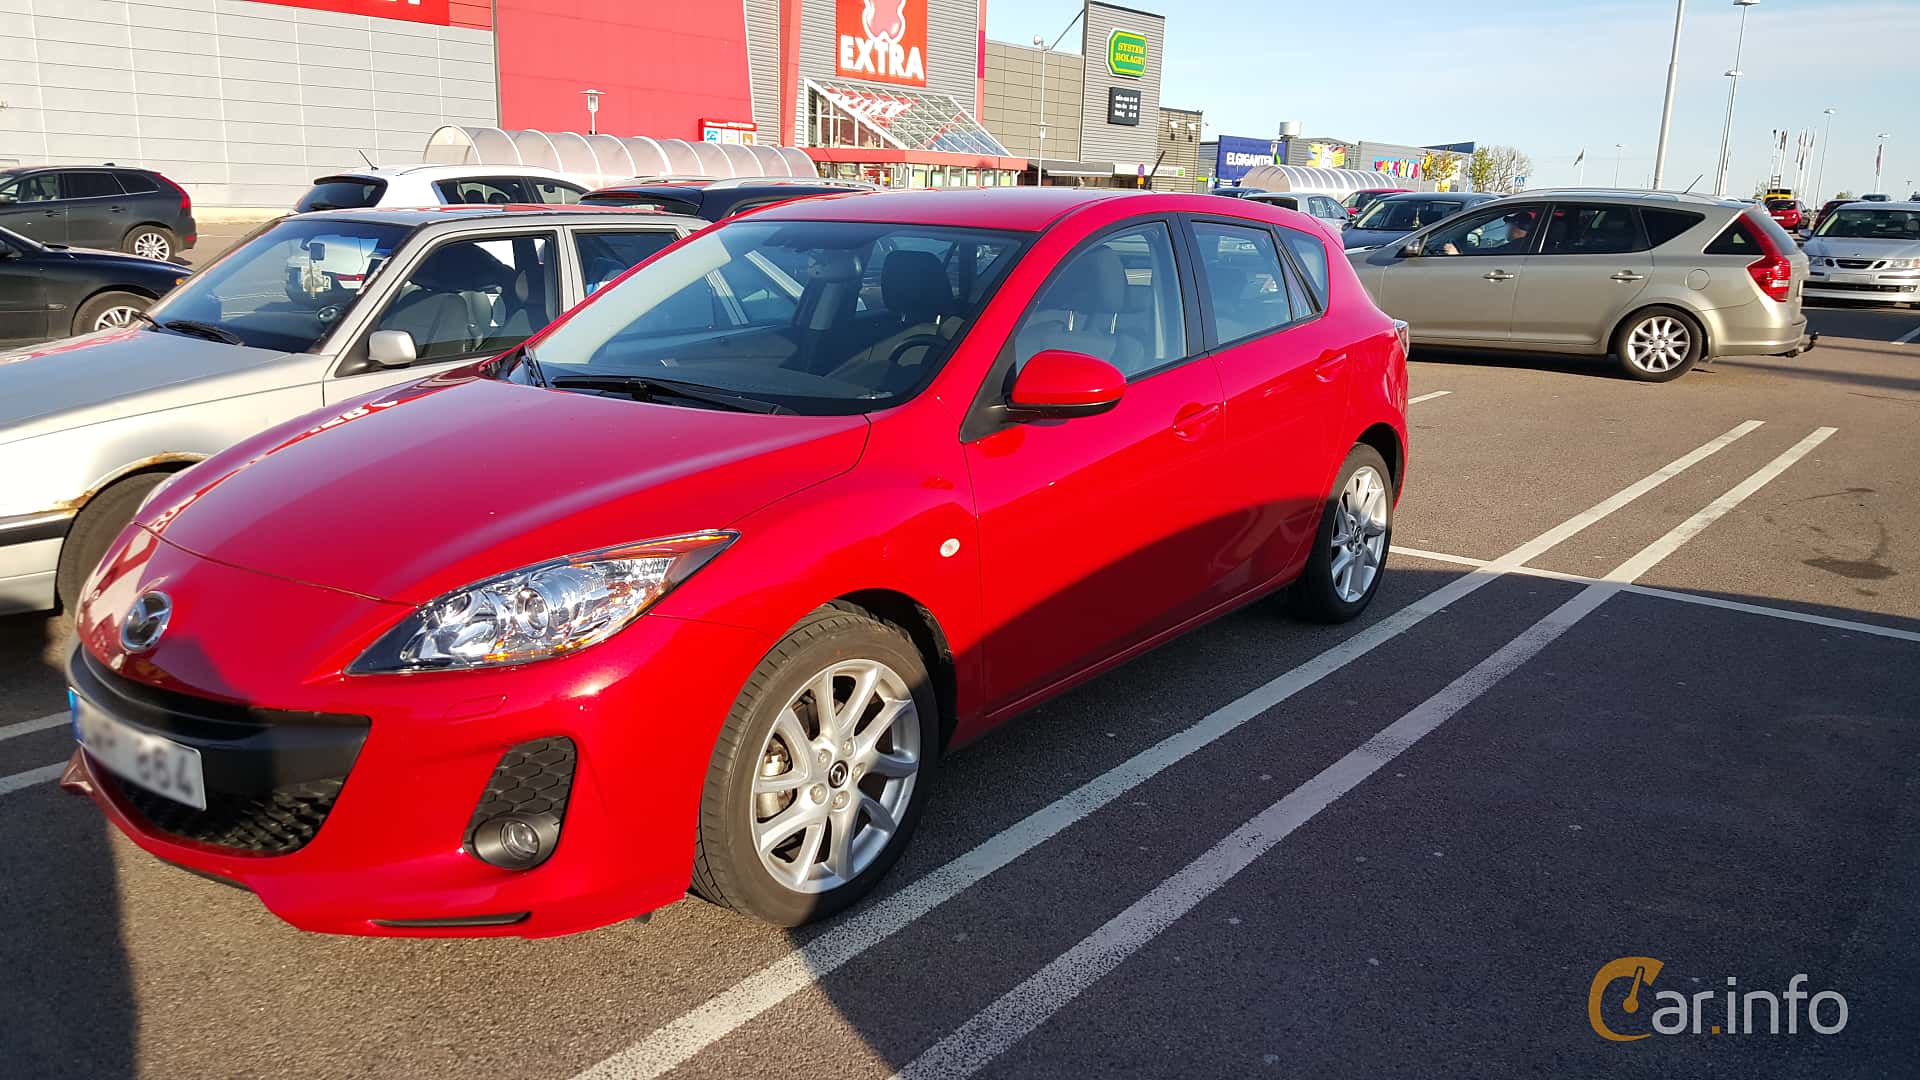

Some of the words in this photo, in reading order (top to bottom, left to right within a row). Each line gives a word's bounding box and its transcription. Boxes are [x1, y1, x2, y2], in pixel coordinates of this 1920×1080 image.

[1118, 42, 1145, 55] SYSTEM
[840, 34, 925, 80] EXTRA
[1115, 52, 1145, 65] BOLAGET
